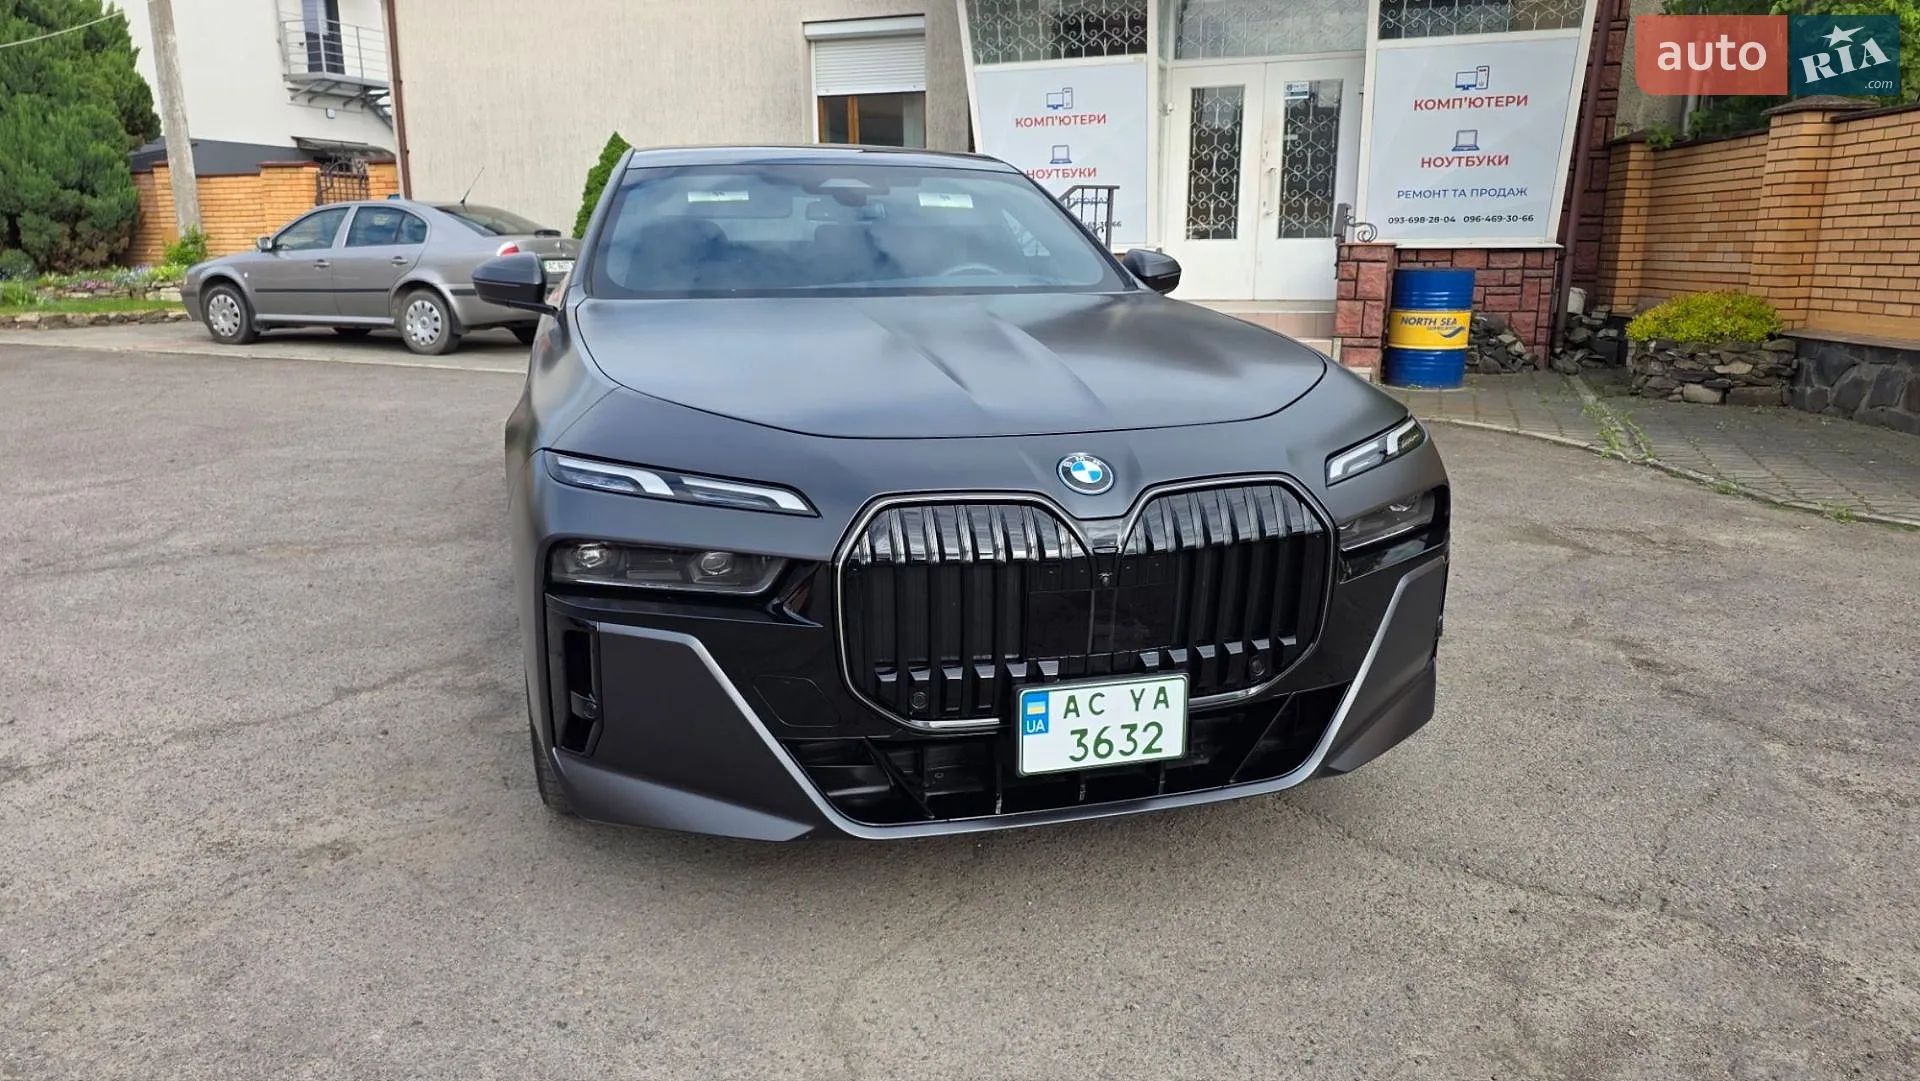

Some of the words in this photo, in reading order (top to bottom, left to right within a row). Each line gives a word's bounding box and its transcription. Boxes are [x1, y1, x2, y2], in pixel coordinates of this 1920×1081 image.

[1413, 95, 1529, 111] КОМП'ЮТЕРИ
[1015, 114, 1107, 128] КОМП'ЮТЕРИ
[1420, 155, 1510, 168] НОУТБУКИ
[1026, 167, 1097, 180] НОУТБУКИ
[1397, 189, 1449, 199] РЕМОНТ
[1452, 188, 1467, 198] ТА
[1470, 187, 1528, 198] ПРОДАЖ
[1387, 216, 1456, 225] 093-698-28-04
[1463, 214, 1534, 223] 096-469-30-66
[1401, 316, 1437, 326] NORTH
[1440, 317, 1457, 326] SEA
[1063, 692, 1105, 719] AC
[1130, 686, 1169, 711] YA
[1026, 719, 1046, 733] UA
[1069, 721, 1163, 762] 3632
